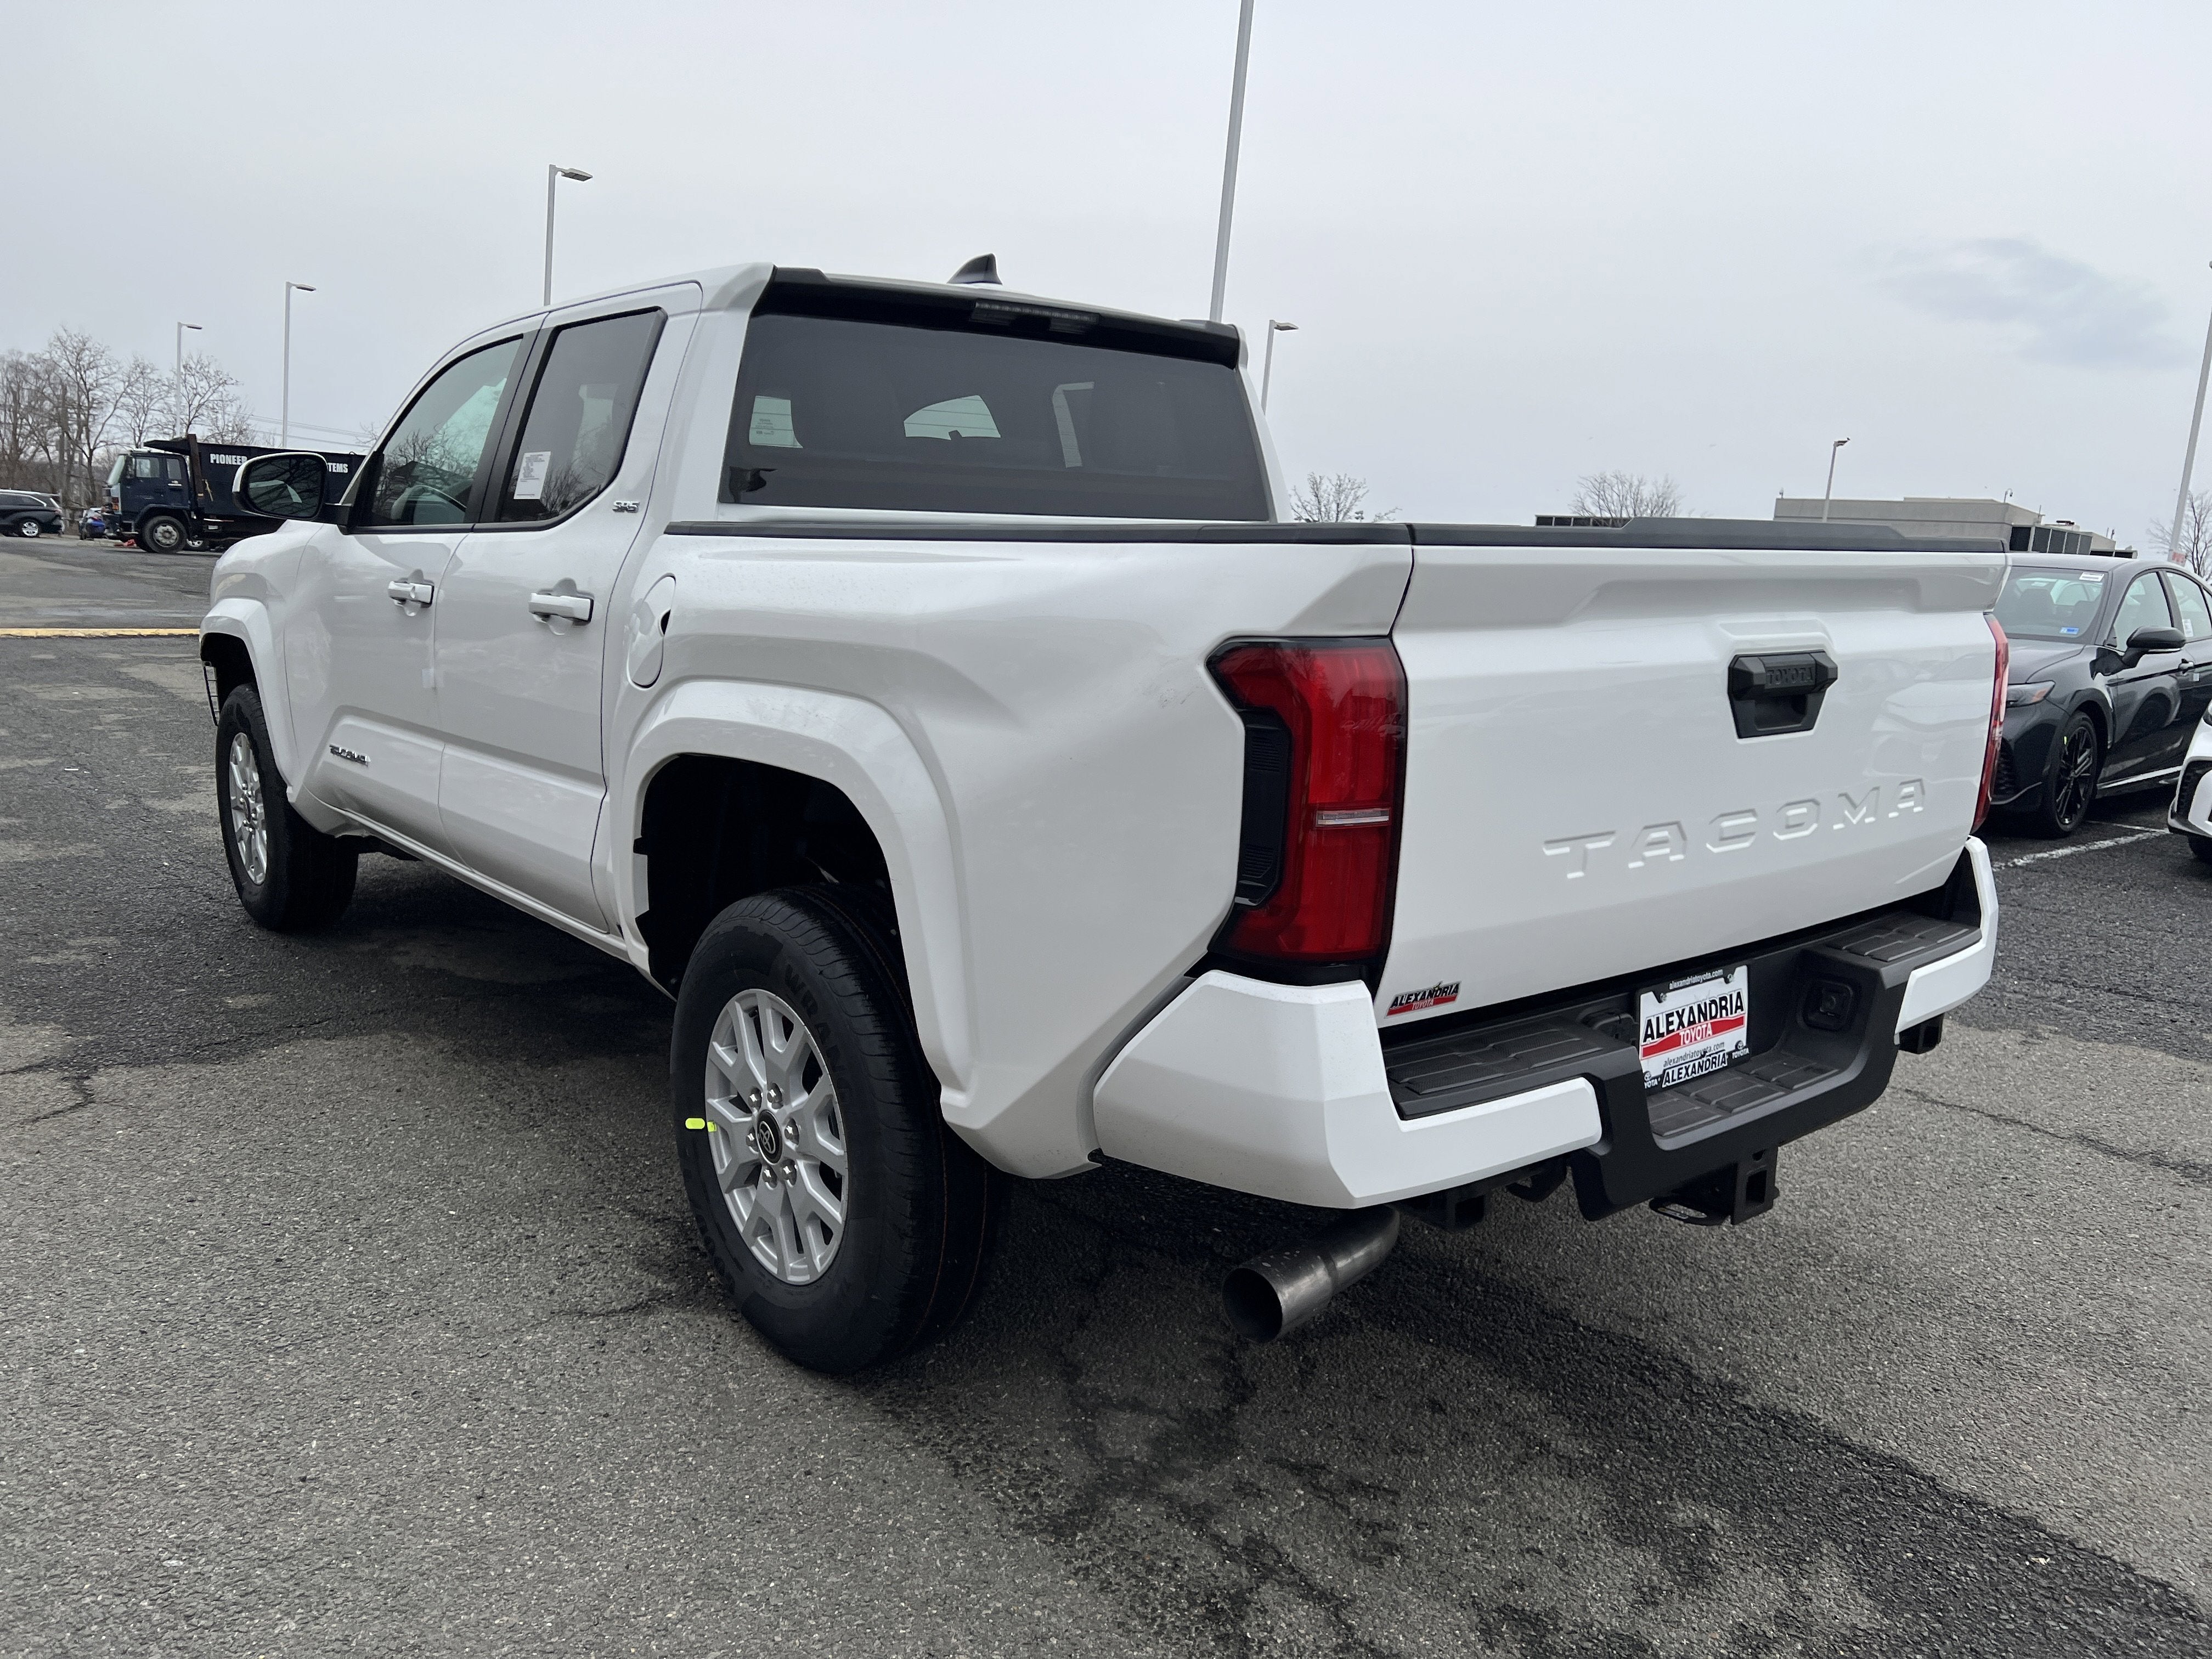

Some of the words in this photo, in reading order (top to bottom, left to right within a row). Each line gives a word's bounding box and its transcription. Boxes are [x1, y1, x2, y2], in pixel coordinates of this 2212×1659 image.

[210, 453, 248, 465] PIONEER
[326, 462, 348, 473] TEMS
[613, 500, 640, 513] SR5
[1767, 667, 1814, 685] TOYOTA
[1542, 778, 1926, 879] TACOMA
[1669, 969, 1724, 990] alexandriatoyota.com
[1390, 983, 1460, 1008] ALEXANDRIA
[1412, 998, 1434, 1011] TOYOTA
[1643, 991, 1744, 1043] ALEXANDRIA
[1679, 1022, 1713, 1046] TOYOTA
[1644, 1078, 1658, 1089] YOTA
[1662, 1052, 1728, 1087] ALEXANDRIA
[1732, 1047, 1750, 1059] TOYOTA
